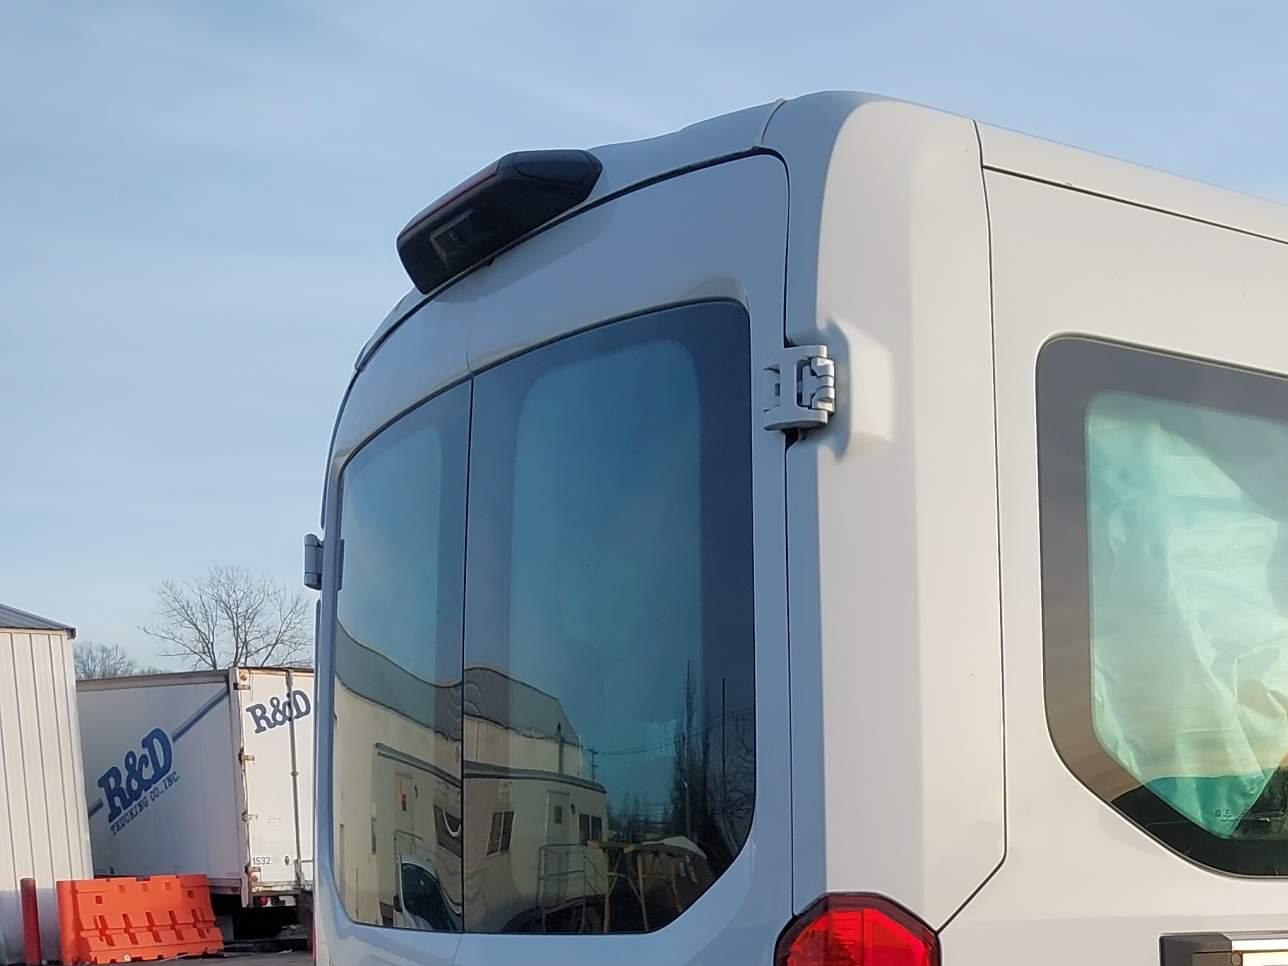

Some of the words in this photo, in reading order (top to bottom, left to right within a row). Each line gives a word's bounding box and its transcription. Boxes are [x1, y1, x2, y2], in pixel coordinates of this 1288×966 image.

[246, 689, 311, 734] R&D
[98, 728, 172, 823] R&D
[111, 797, 149, 835] TRUCKING
[252, 857, 270, 867] 1532
